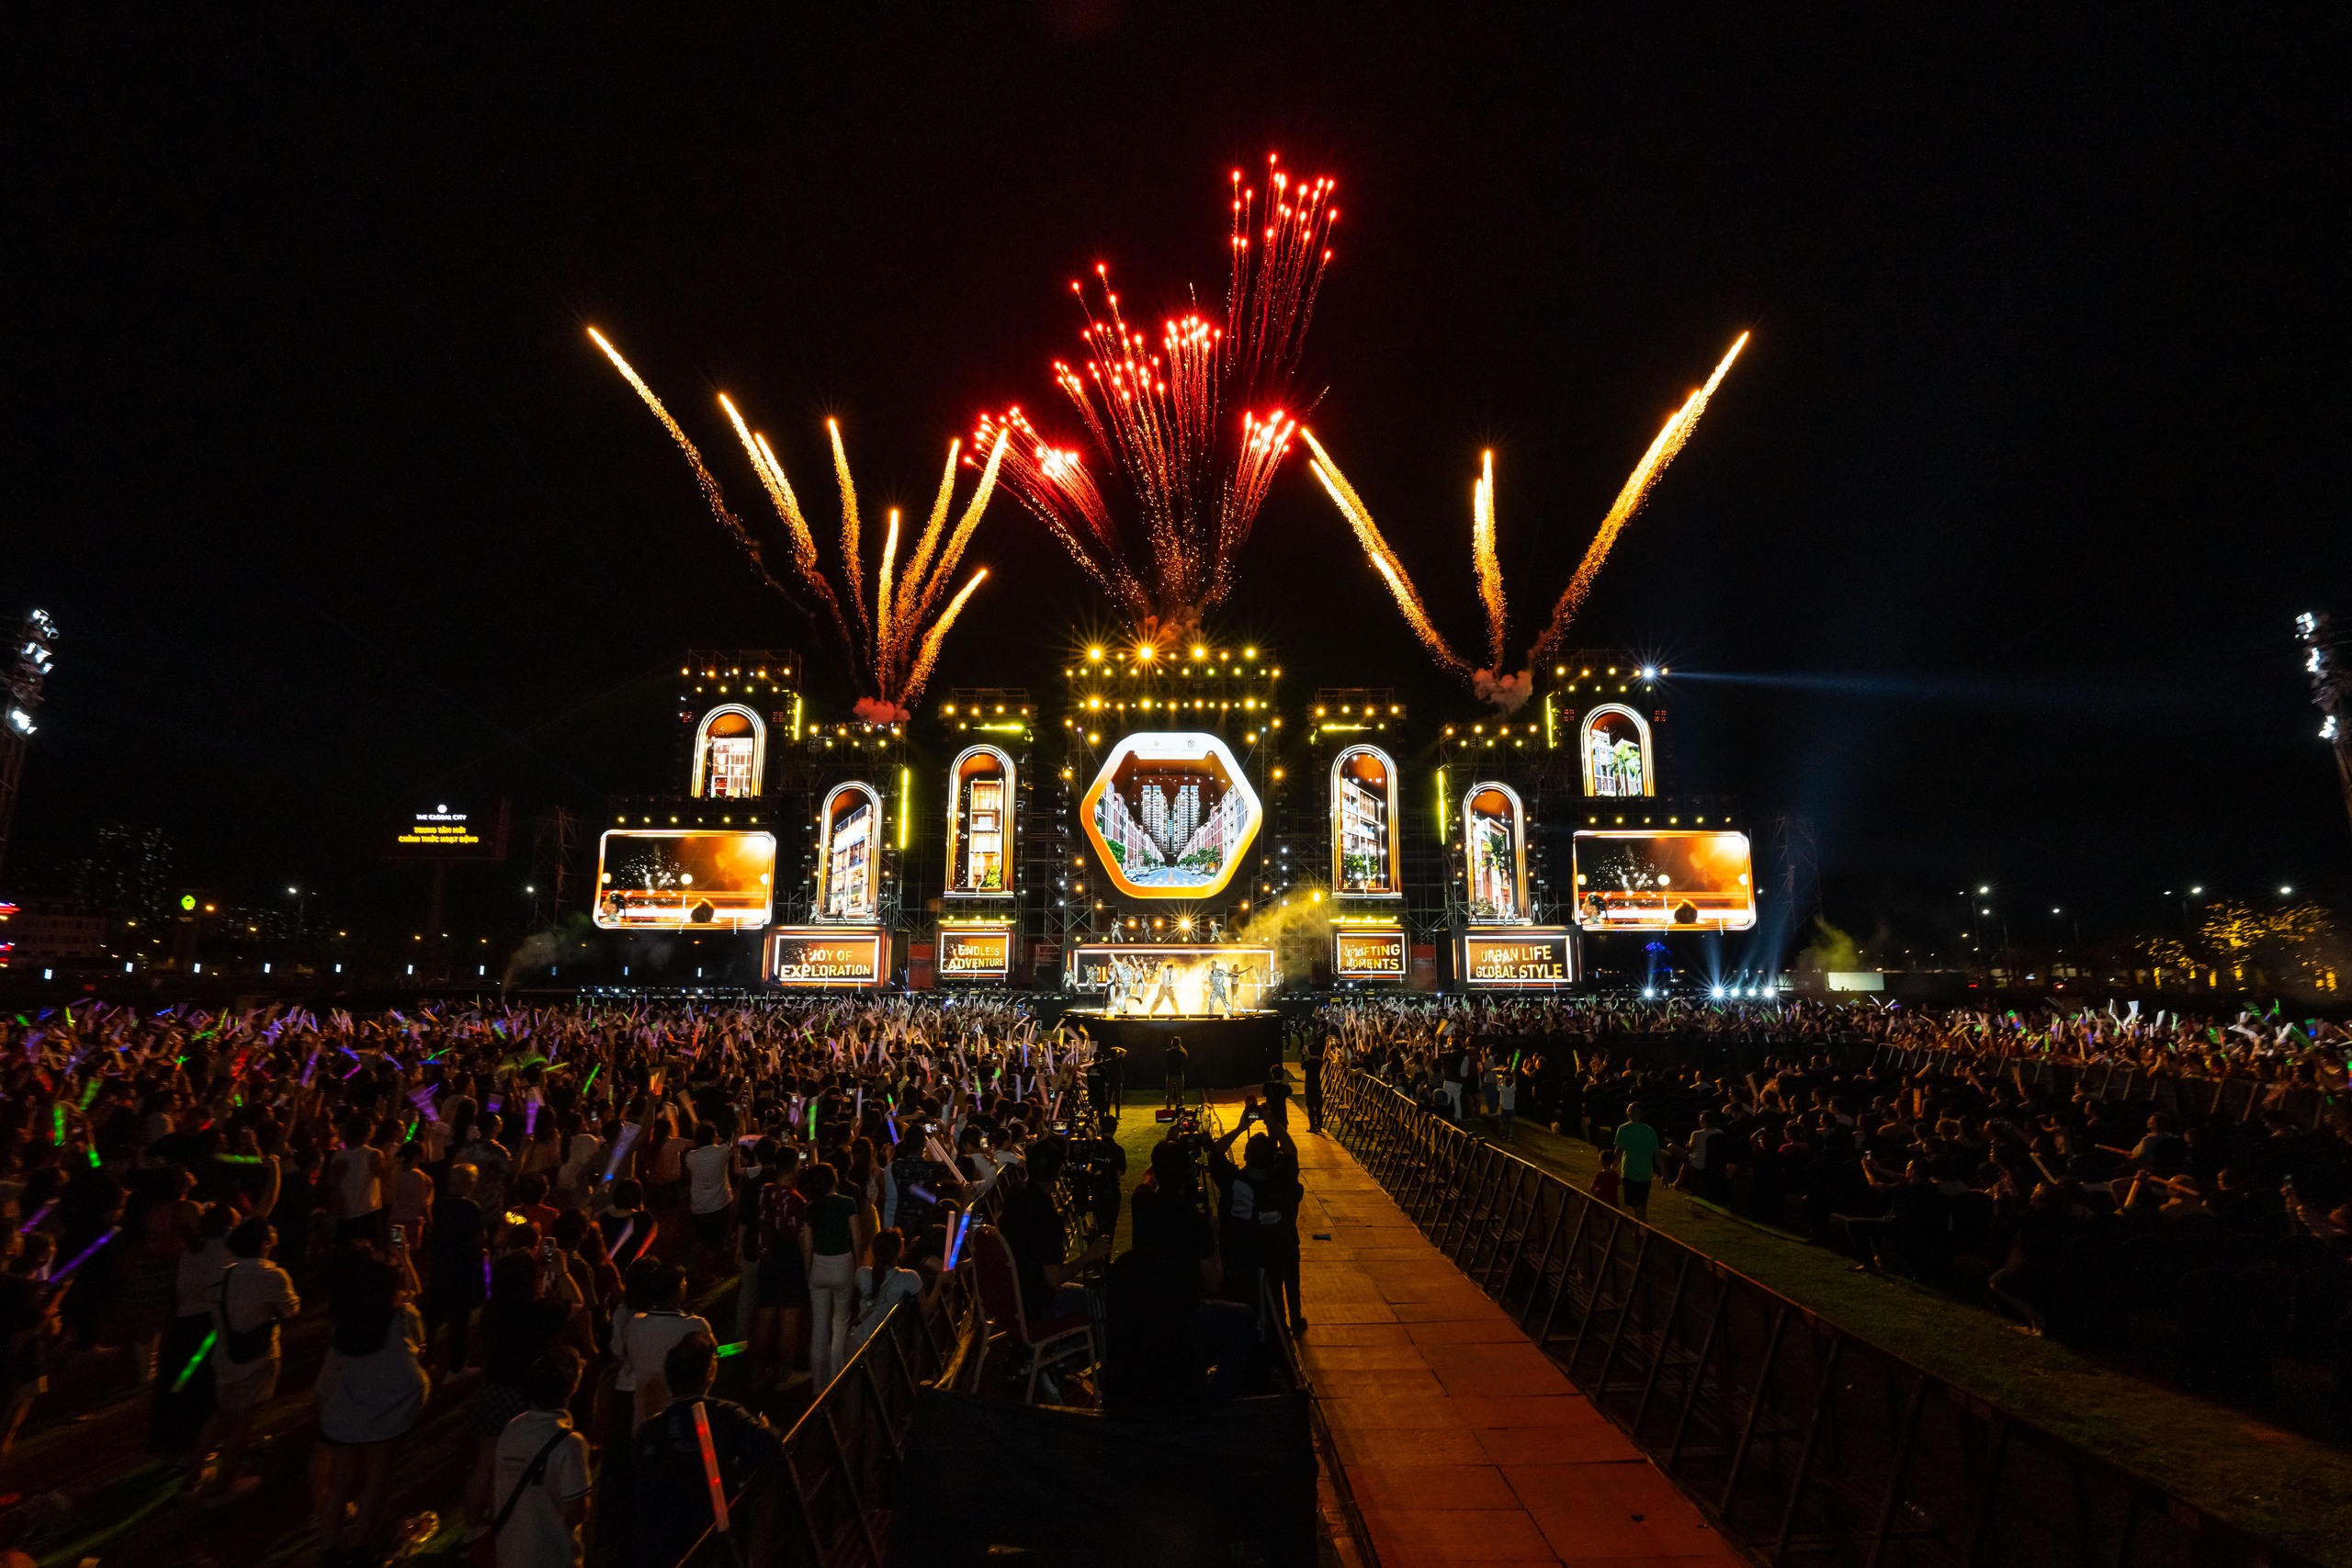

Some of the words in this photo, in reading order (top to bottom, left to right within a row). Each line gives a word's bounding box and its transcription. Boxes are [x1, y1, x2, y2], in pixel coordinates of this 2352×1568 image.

[808, 949, 834, 962] JOY
[836, 950, 853, 962] OF
[957, 943, 1000, 956] ENDLESS
[1481, 947, 1519, 963] URBAN
[1521, 944, 1552, 961] LIFE
[780, 964, 871, 978] EXPLORATION
[946, 957, 1004, 971] ADVENTURE
[1346, 958, 1399, 970] MOMENTS
[1476, 964, 1517, 979] GLOBAL
[1519, 963, 1564, 979] STYLE
